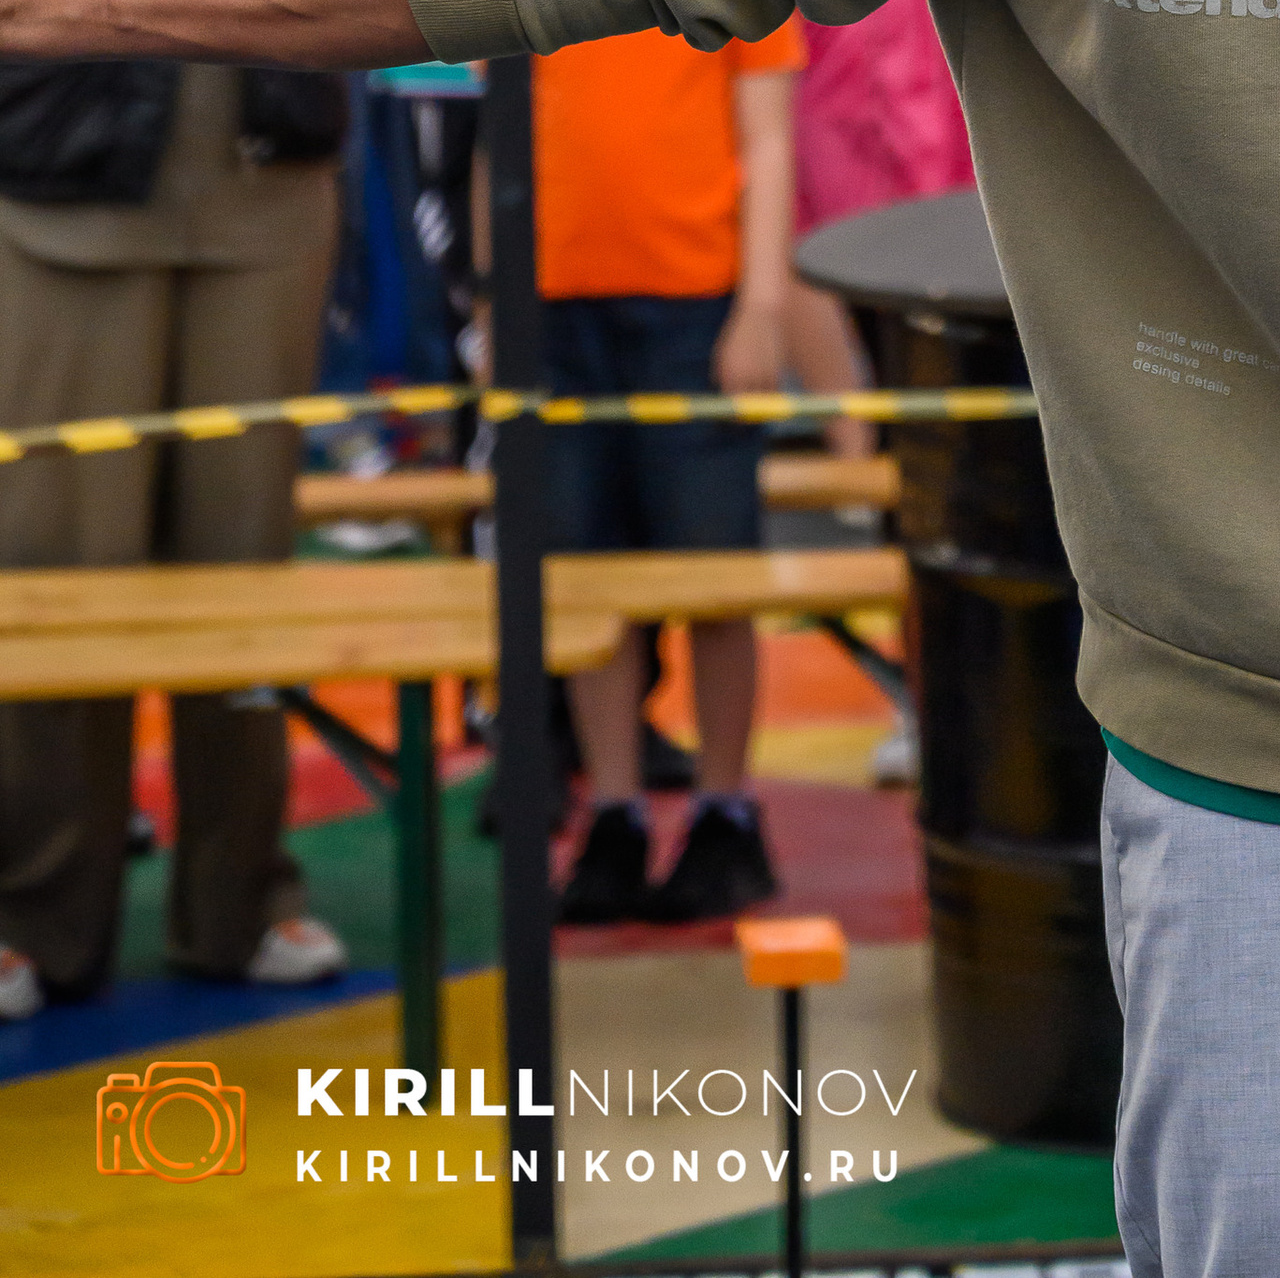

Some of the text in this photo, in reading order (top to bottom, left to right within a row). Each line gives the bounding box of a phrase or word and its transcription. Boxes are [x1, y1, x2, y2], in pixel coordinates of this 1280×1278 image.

[1136, 340, 1200, 369] exclusive
[1190, 338, 1219, 356] with
[1222, 346, 1259, 366] great
[1132, 357, 1231, 396] desing details
